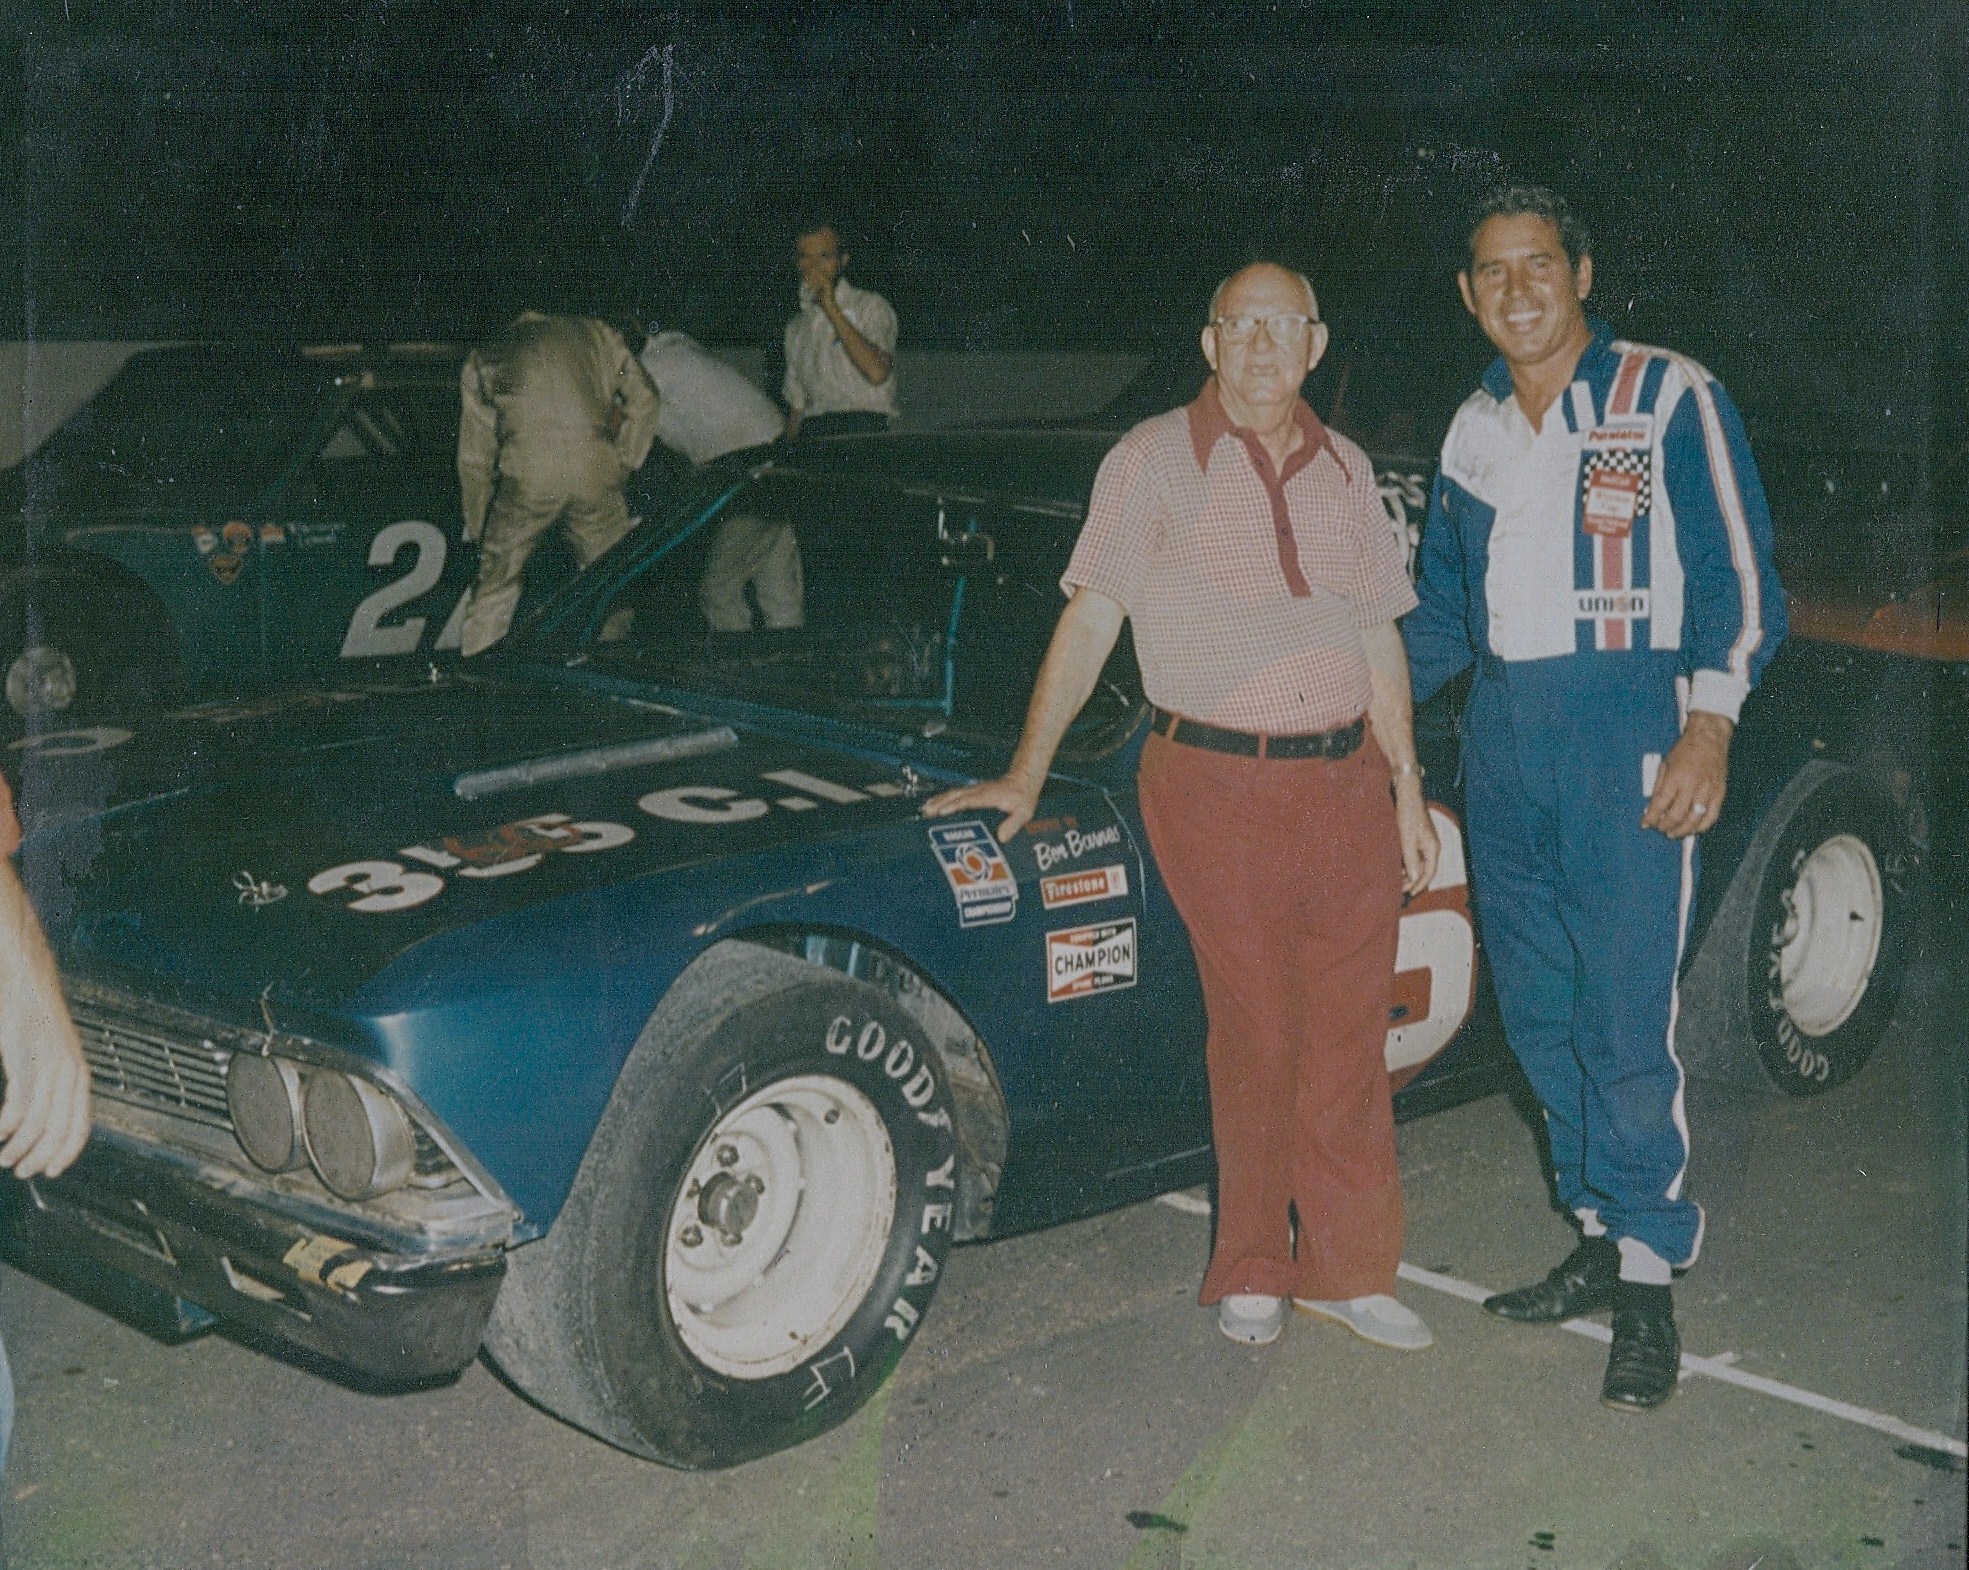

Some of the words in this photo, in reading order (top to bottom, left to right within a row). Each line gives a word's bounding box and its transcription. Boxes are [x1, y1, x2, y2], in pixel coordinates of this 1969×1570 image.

[1046, 877, 1106, 901] Firestone
[1054, 943, 1131, 975] CHAMPION
[826, 1014, 956, 1341] GOODYEAR
